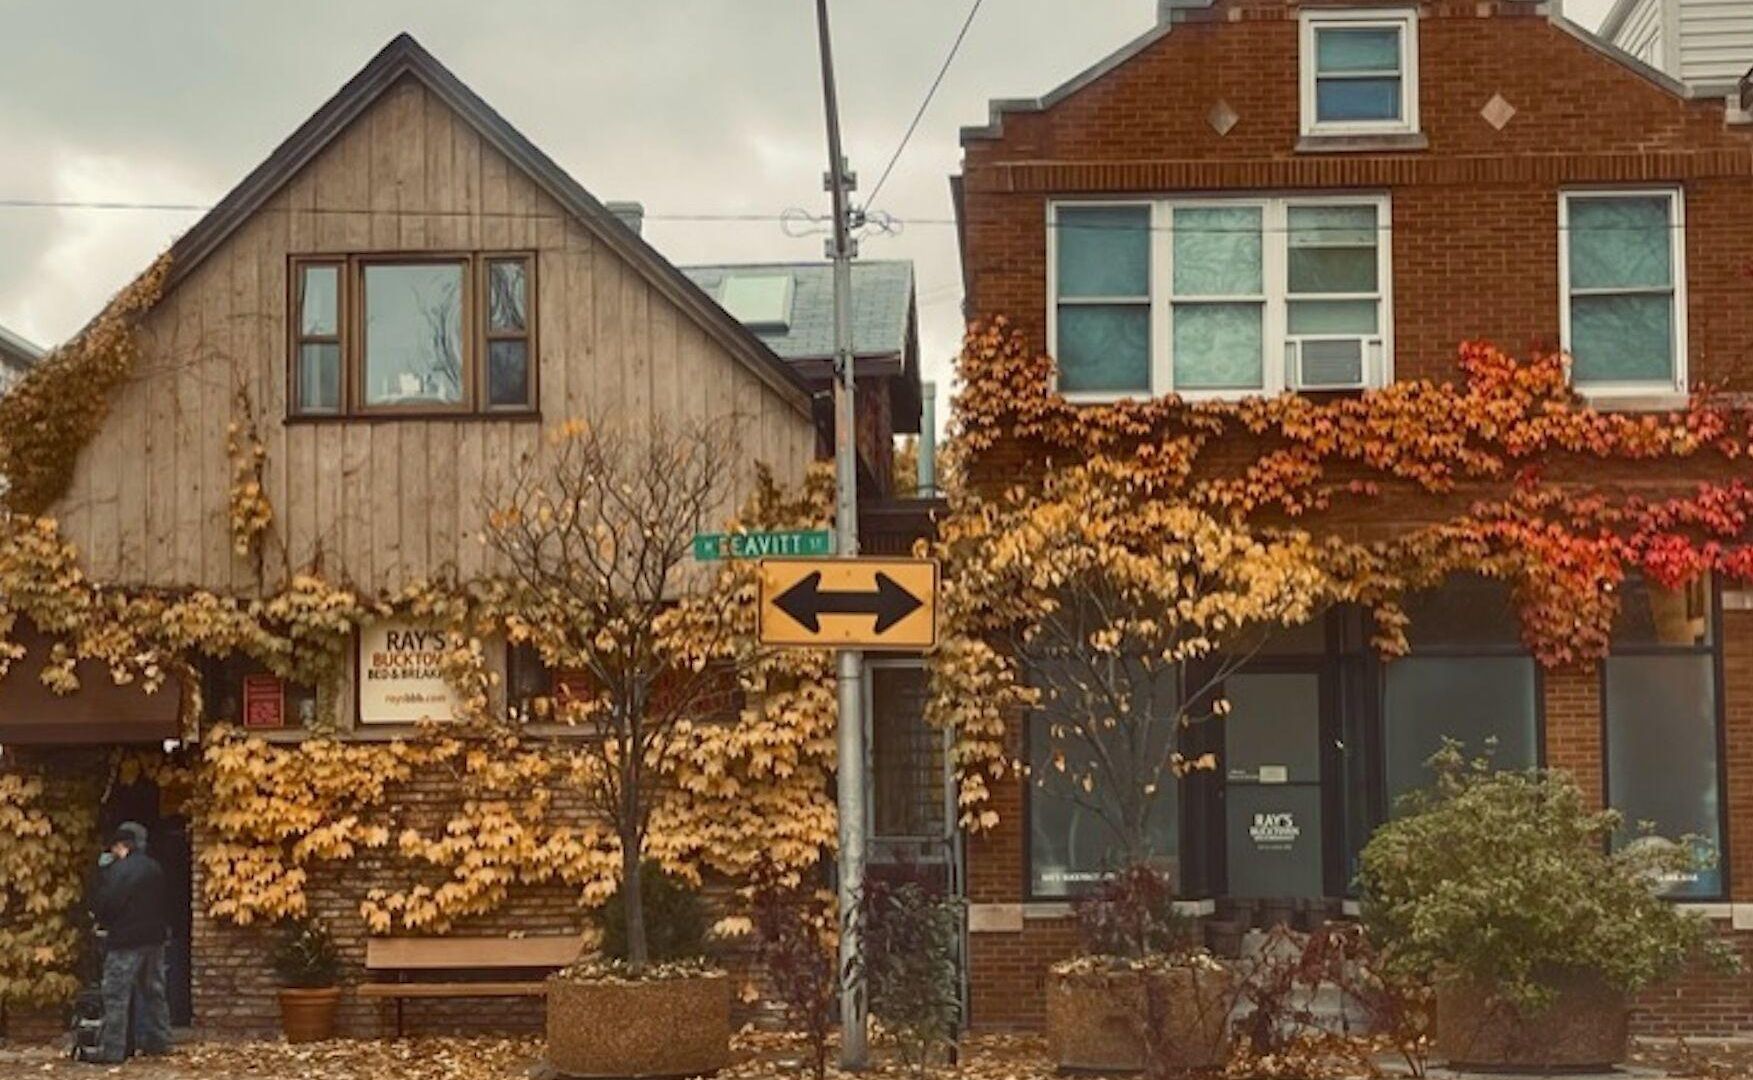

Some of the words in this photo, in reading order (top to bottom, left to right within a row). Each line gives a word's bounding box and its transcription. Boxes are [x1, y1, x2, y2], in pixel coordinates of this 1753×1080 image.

[386, 630, 446, 650] RAY'S
[372, 652, 443, 667] BUCKTOW
[401, 669, 442, 679] BREAK
[1254, 813, 1294, 827] RAY'S
